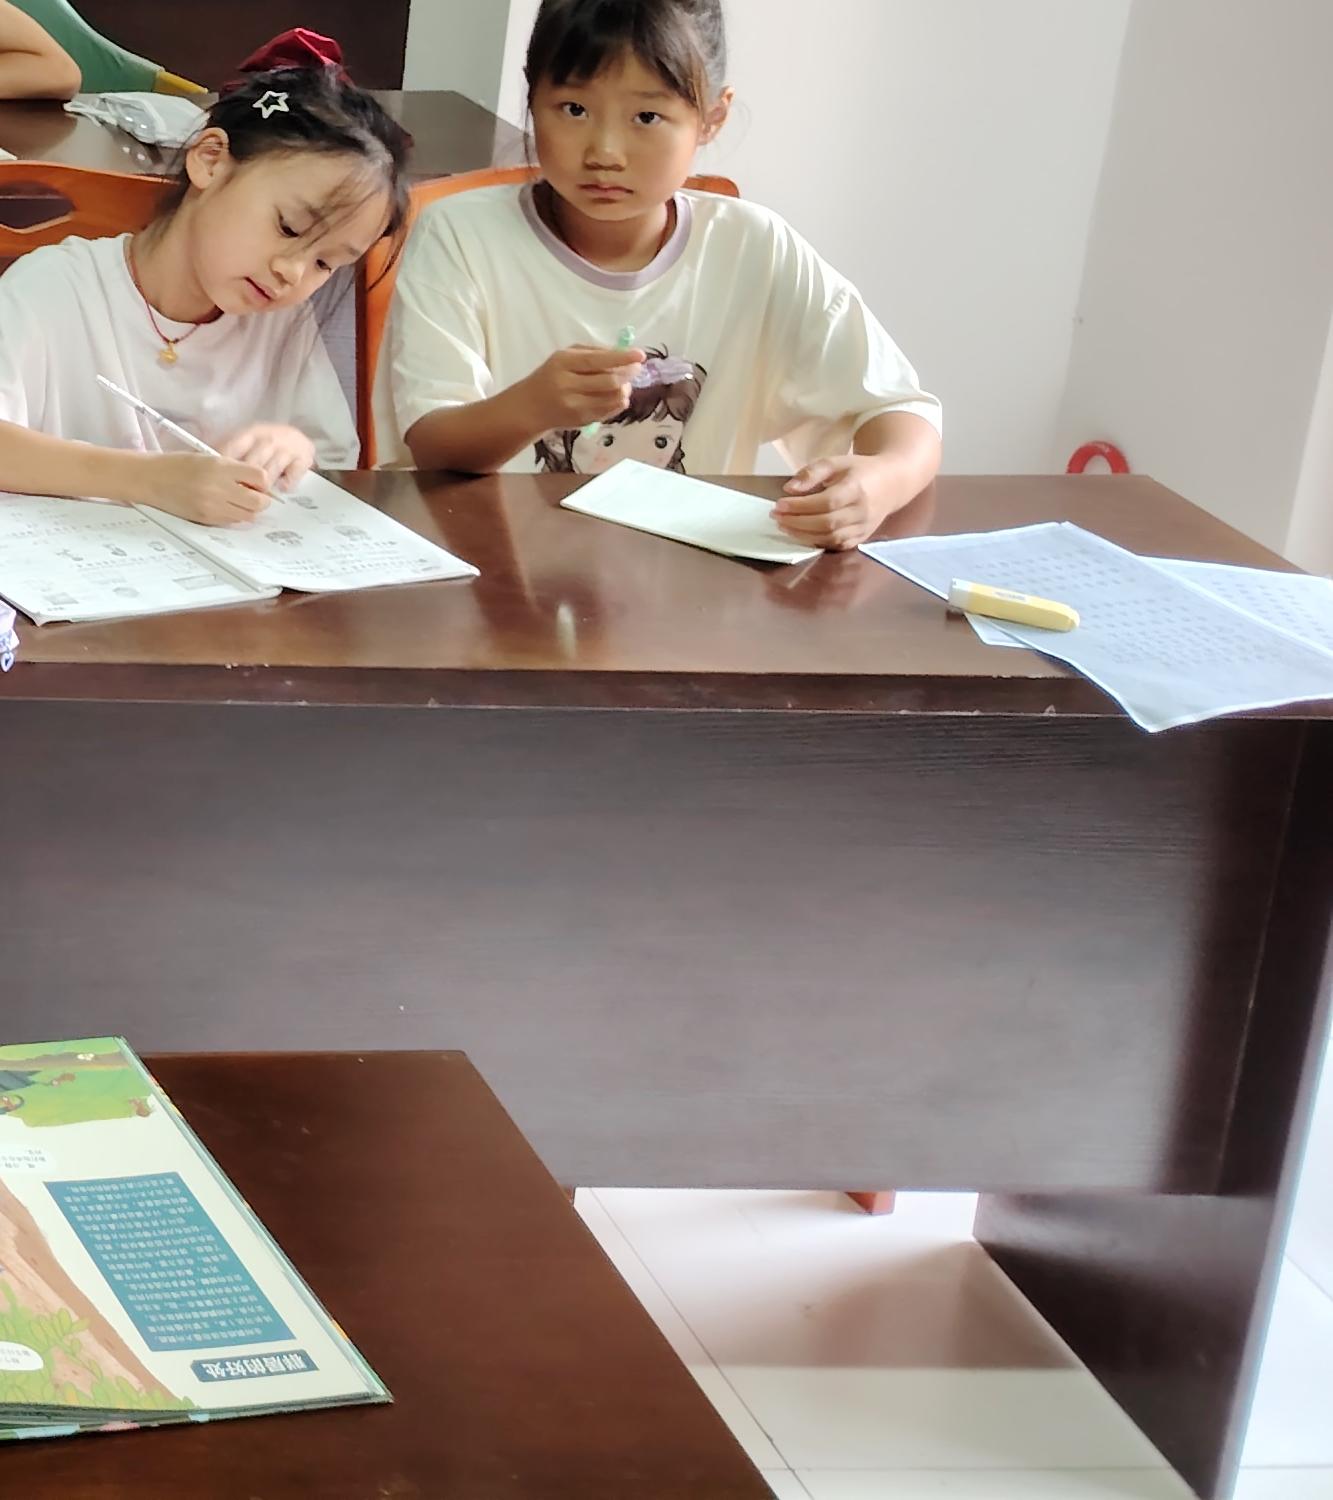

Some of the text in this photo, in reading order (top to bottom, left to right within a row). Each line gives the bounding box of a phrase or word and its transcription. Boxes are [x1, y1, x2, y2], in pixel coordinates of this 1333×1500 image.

[200, 1353, 308, 1378] 群居的好处
